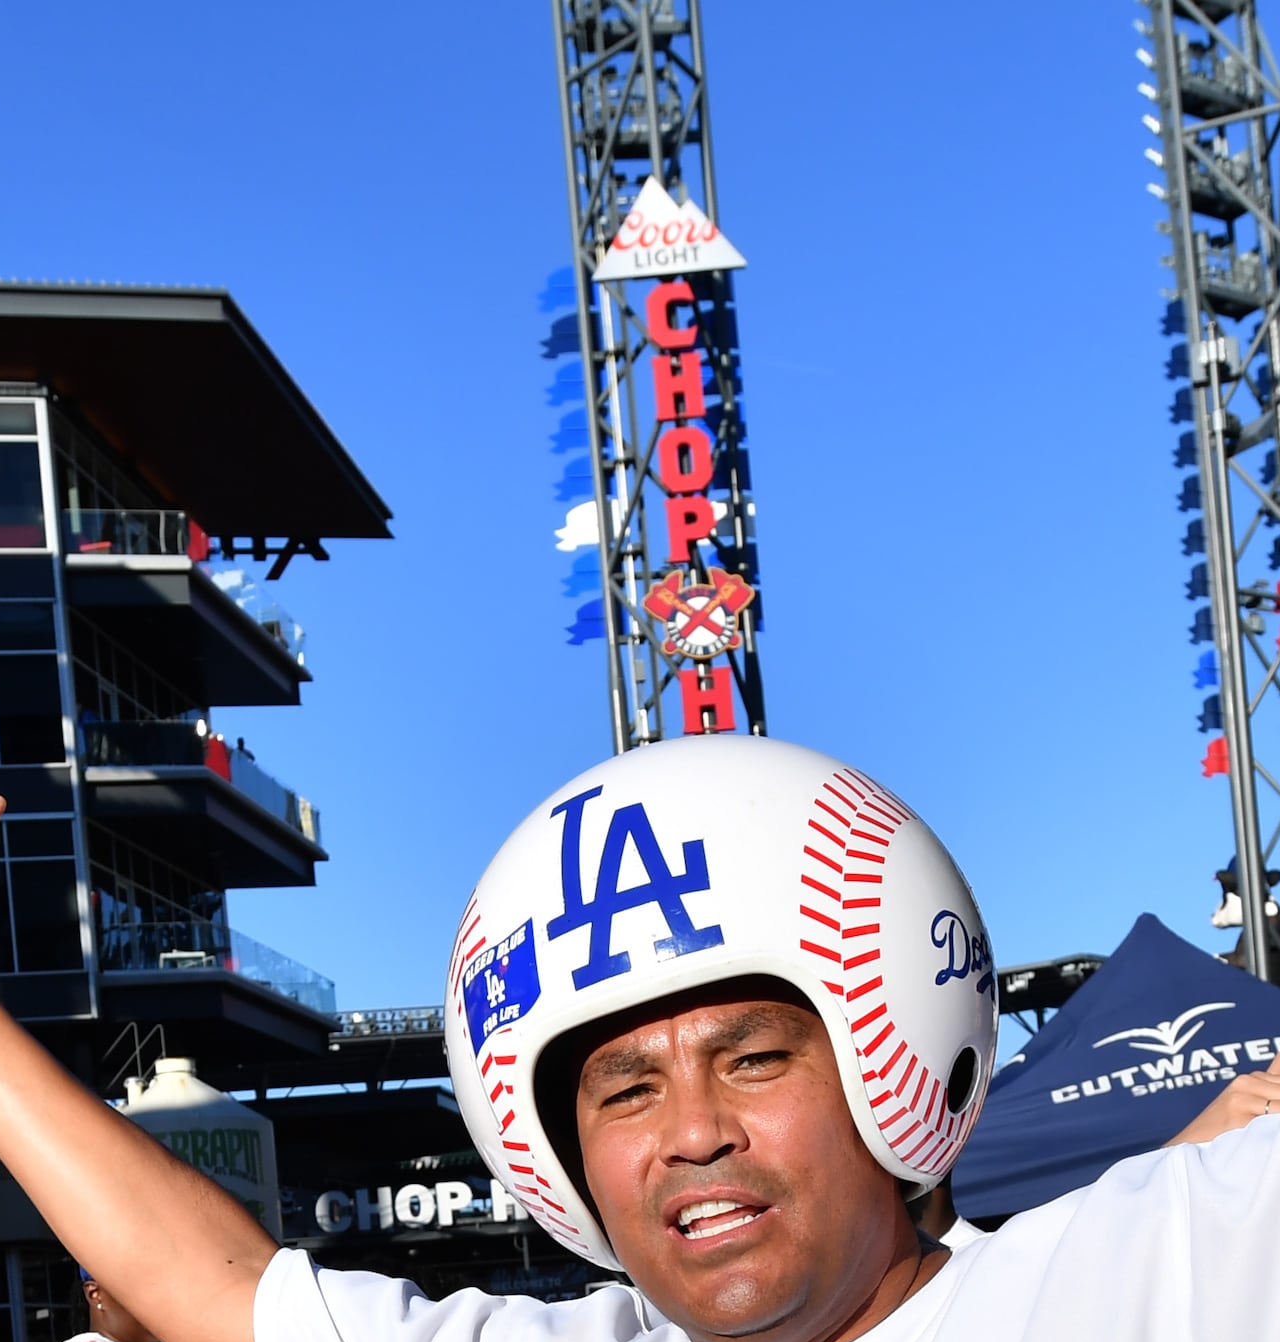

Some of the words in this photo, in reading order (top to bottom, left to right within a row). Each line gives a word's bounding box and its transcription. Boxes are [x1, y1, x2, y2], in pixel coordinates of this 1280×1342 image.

[611, 209, 720, 251] Coors
[634, 246, 701, 269] LIGHT
[646, 280, 719, 564] CHOP
[546, 784, 725, 991] LA
[465, 948, 496, 988] BLEED
[496, 925, 527, 961] BLUE
[484, 968, 506, 1008] LA
[483, 1012, 498, 1037] FOR
[500, 1003, 520, 1022] LIFE
[1131, 1066, 1237, 1097] SPIRITS
[154, 1128, 266, 1185] RRAPIN
[315, 1180, 472, 1233] CHOP
